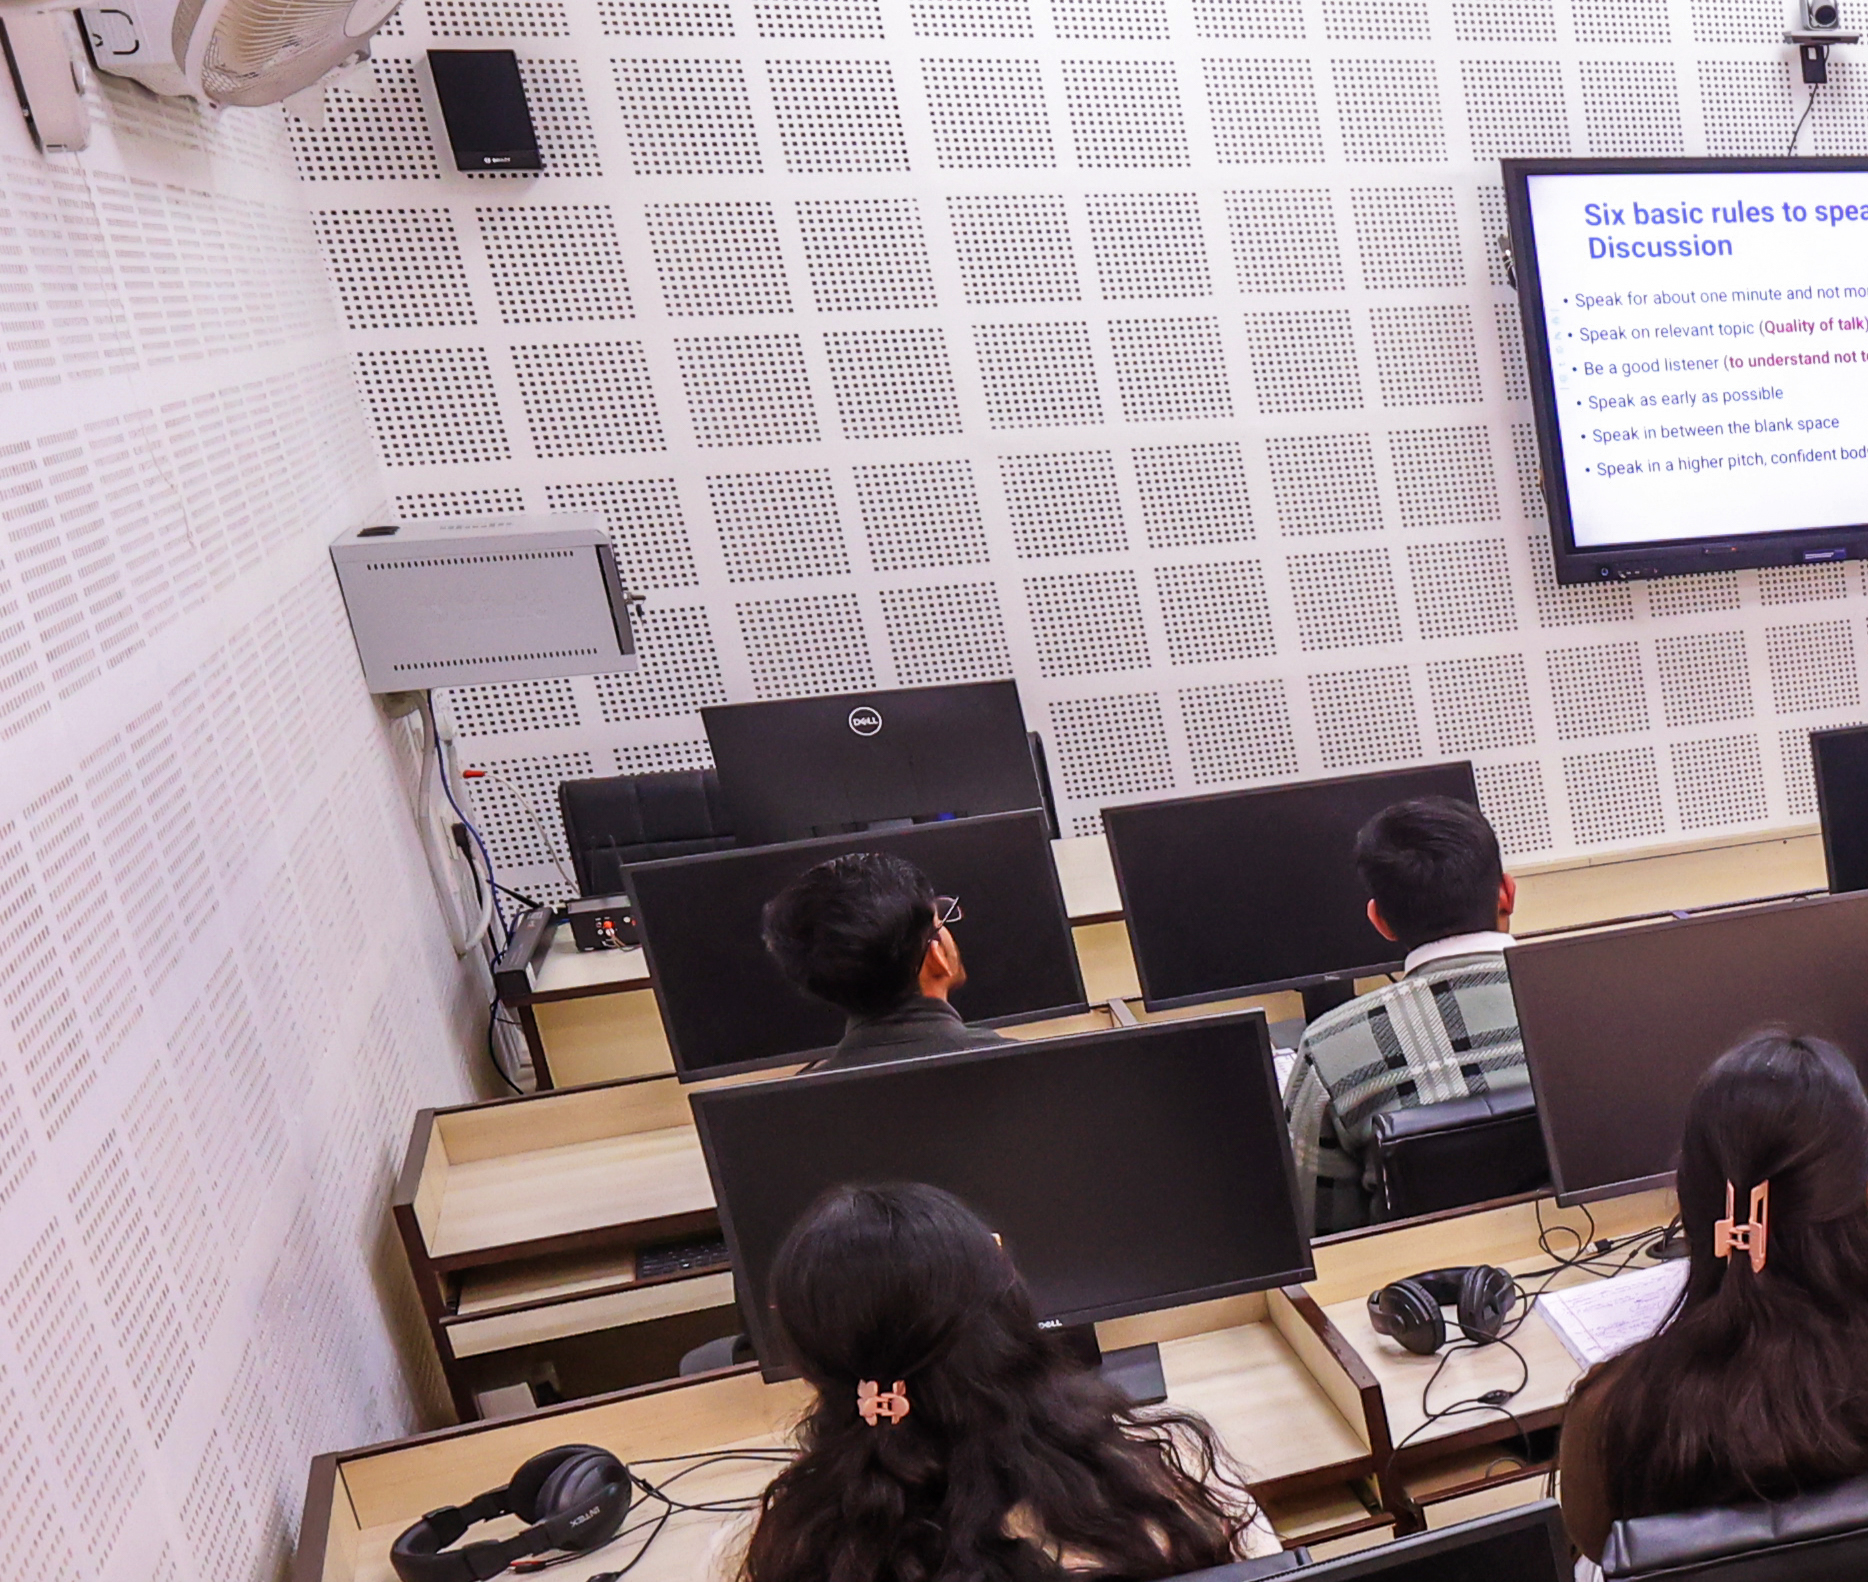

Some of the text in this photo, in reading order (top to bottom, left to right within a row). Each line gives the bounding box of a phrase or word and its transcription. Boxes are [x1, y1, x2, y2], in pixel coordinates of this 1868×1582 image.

[1584, 202, 1626, 227] Six
[1632, 201, 1704, 226] basic
[1711, 199, 1775, 224] rules
[1781, 201, 1808, 223] to
[1588, 233, 1733, 260] Discussion
[1575, 291, 1623, 311] Speak
[1627, 290, 1648, 306] for
[1653, 290, 1697, 305] about
[1700, 291, 1728, 303] one
[1731, 288, 1782, 302] minute
[1786, 285, 1813, 301] and
[1817, 286, 1840, 299] not
[1579, 325, 1627, 345] Speak
[1631, 327, 1650, 340] on
[1654, 324, 1715, 338] relevant
[1718, 323, 1754, 338] topic
[1759, 318, 1815, 337] (Quality
[1819, 316, 1835, 332] of
[1583, 361, 1604, 376] Be
[1608, 363, 1618, 375] a
[1621, 358, 1660, 378] good
[1664, 358, 1719, 372] listener
[1723, 355, 1744, 372] (to
[1748, 350, 1831, 368] understand
[1834, 350, 1858, 364] not
[1588, 386, 1784, 412] Speak as early as possible
[1592, 417, 1840, 446] Speak in between the blank space
[1596, 459, 1644, 479] Speak
[1648, 461, 1661, 473] in
[1665, 460, 1674, 472] a
[1678, 455, 1724, 474] higher
[1727, 452, 1767, 471] pitch,
[1770, 448, 1838, 465] confident
[1038, 1318, 1063, 1330] DELL
